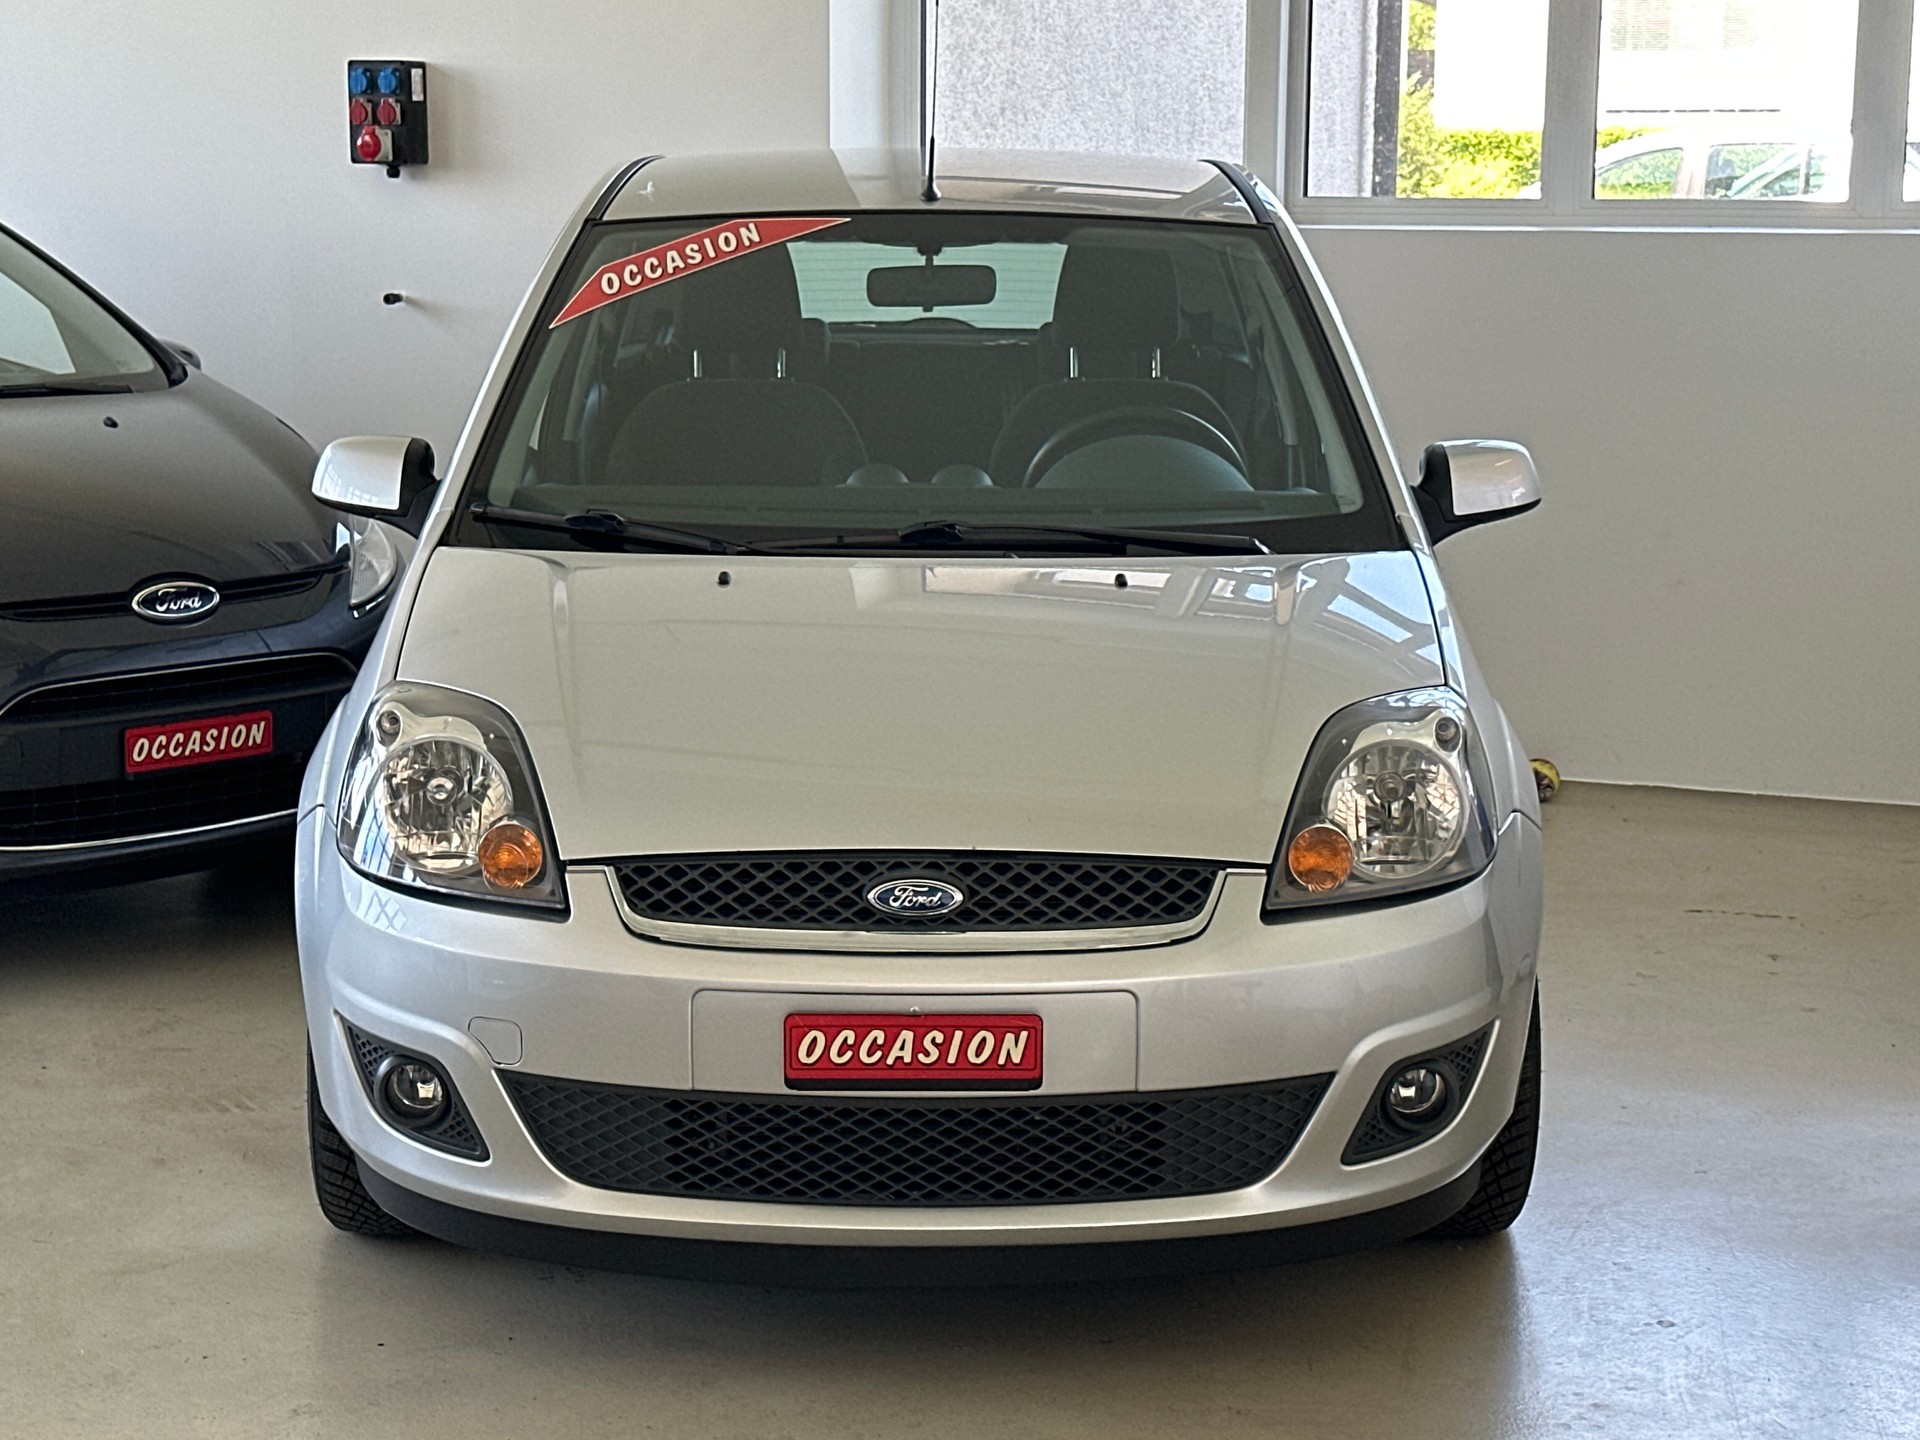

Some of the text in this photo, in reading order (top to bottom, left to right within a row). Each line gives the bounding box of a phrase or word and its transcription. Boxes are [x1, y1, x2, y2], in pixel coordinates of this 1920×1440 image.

[601, 223, 761, 295] OCCASION
[156, 587, 202, 612] Ford
[132, 721, 266, 762] OCCASION
[889, 886, 942, 907] Ford
[798, 1029, 1029, 1066] OCCASION
